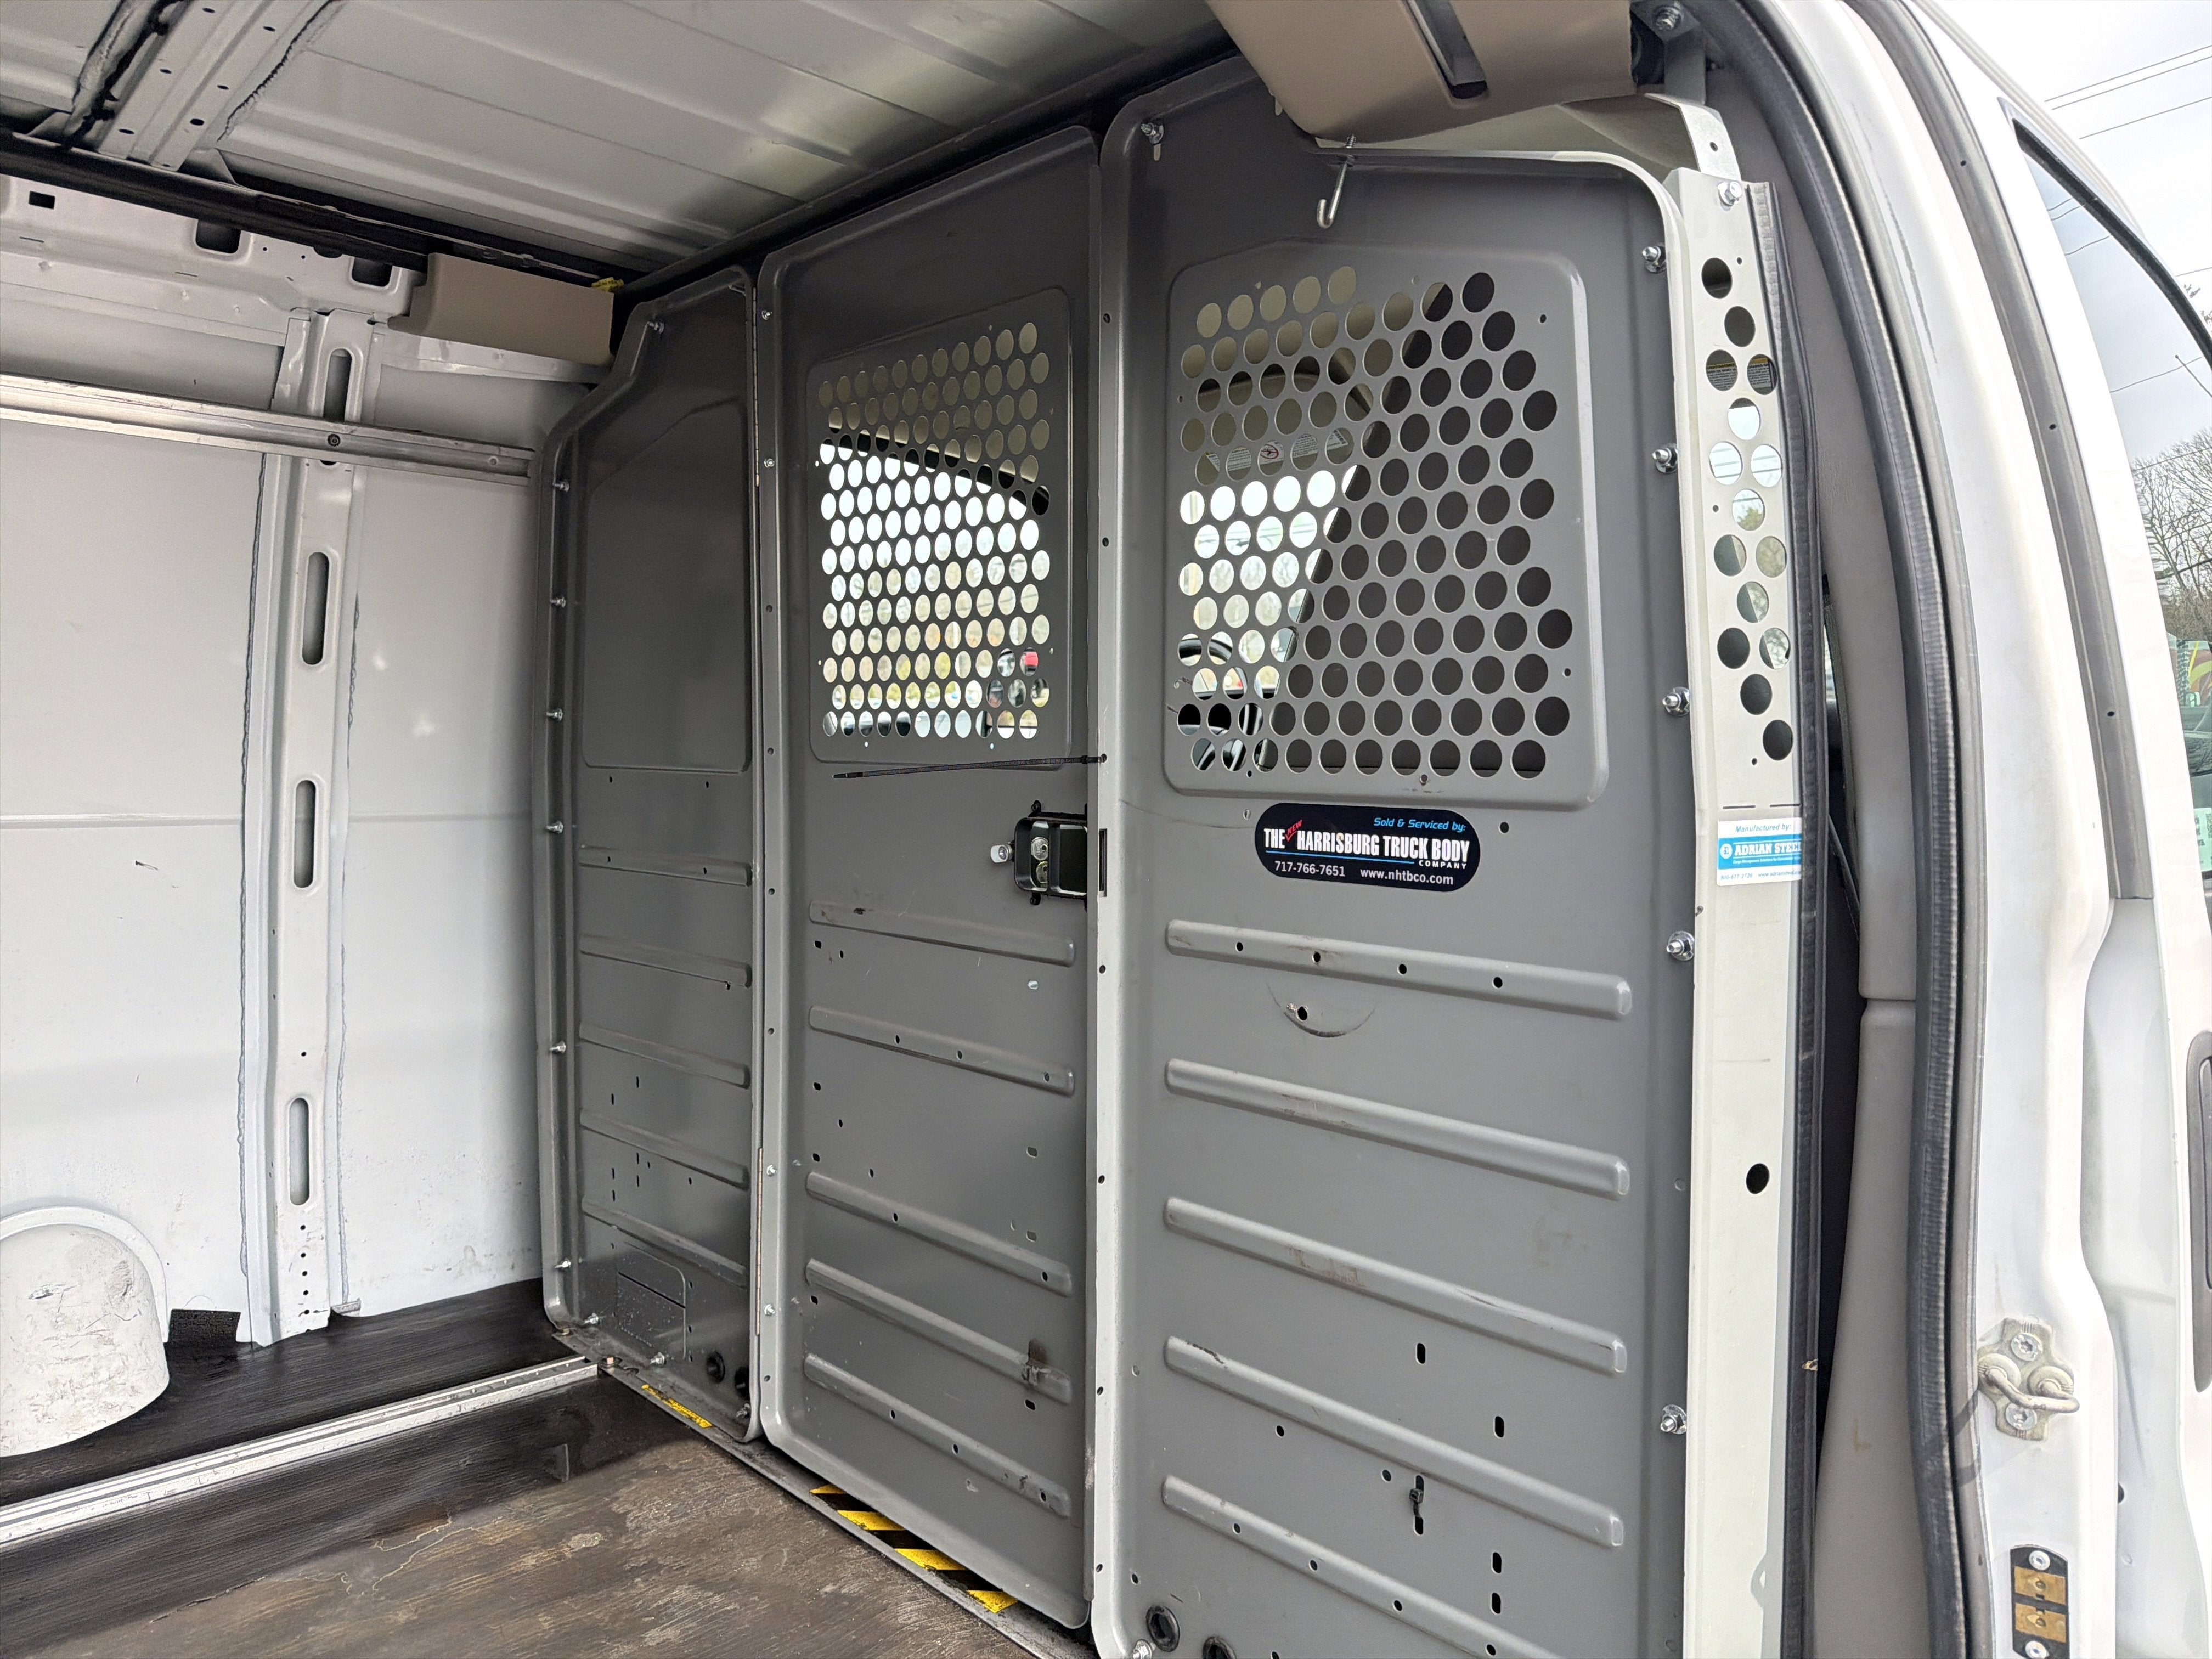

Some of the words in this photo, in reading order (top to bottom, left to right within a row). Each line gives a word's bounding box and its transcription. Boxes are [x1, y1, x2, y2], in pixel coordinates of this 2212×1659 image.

[1373, 817, 1395, 827] Sold
[1397, 819, 1406, 827] &
[1408, 820, 1449, 830] Serviced
[1452, 822, 1466, 833] by:
[1735, 823, 1780, 832] Manufactured
[1263, 828, 1285, 849] THE
[1286, 819, 1303, 835] NEW
[1297, 830, 1380, 856] HARRISBURG
[1383, 836, 1429, 859] TRUCK
[1431, 838, 1470, 862] BODY
[1734, 843, 1773, 856] ADRIAN
[1274, 860, 1345, 877] 717-766-7651
[1419, 860, 1467, 870] COMPANY
[1360, 869, 1453, 885] www.nhtbco.com
